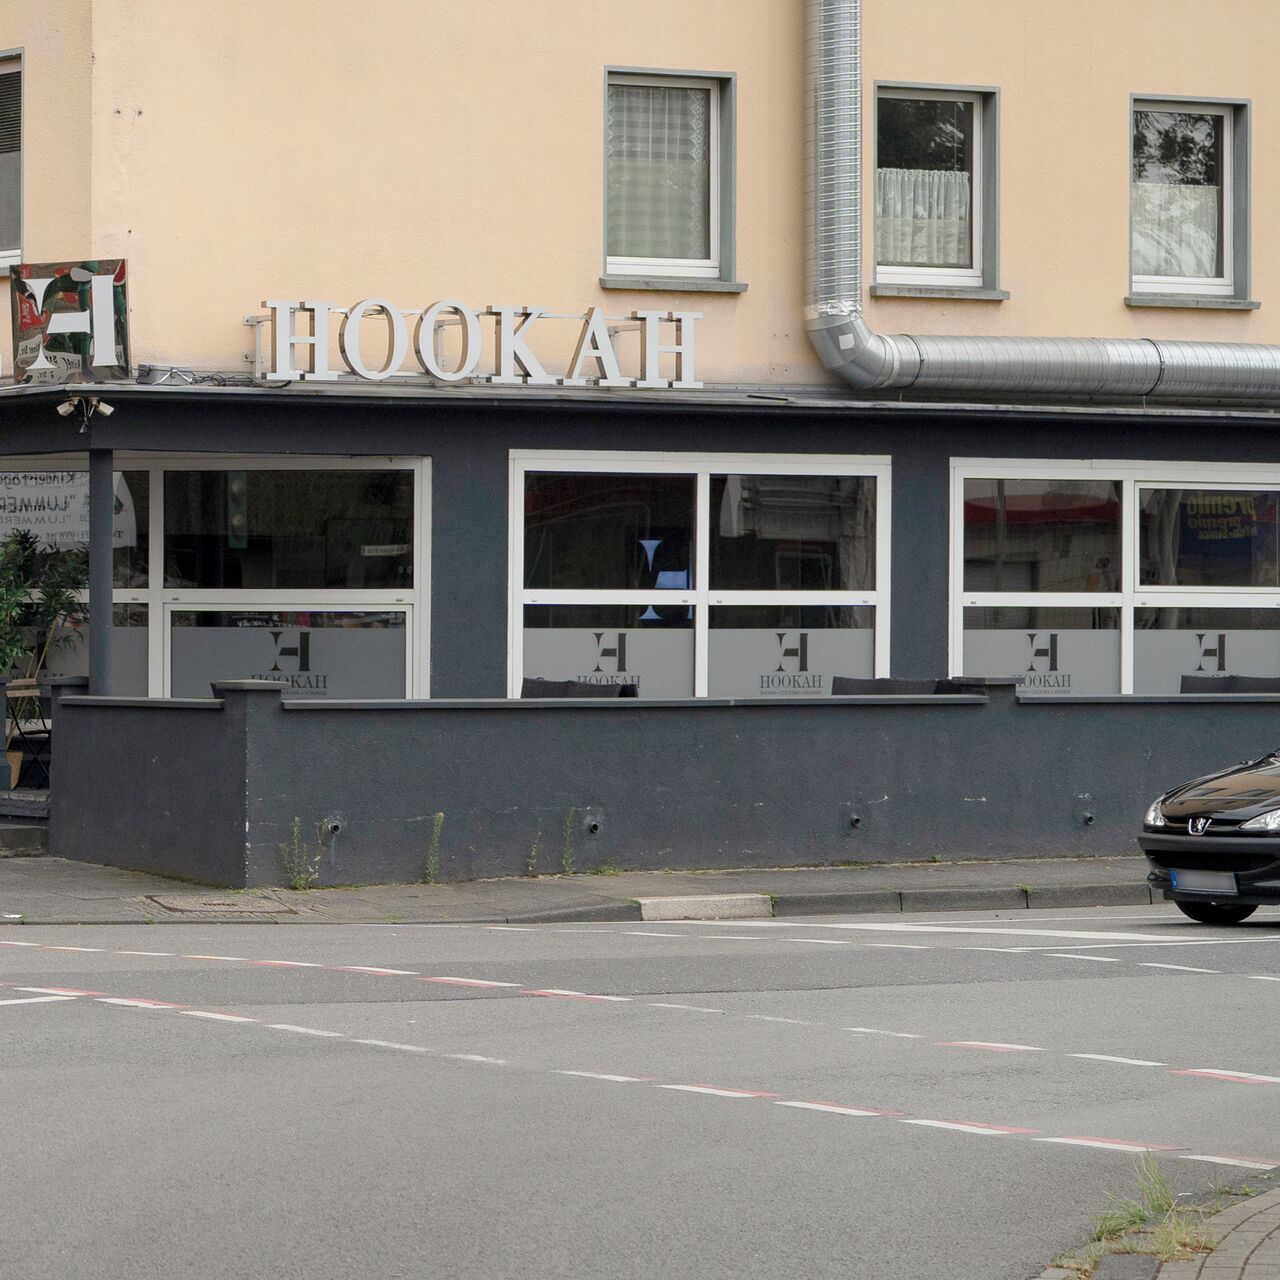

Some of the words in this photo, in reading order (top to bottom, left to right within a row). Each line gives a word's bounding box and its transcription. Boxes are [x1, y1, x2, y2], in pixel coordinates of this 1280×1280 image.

[262, 298, 704, 389] HOOKAH
[759, 674, 823, 689] HOOKAH
[1013, 674, 1072, 688] OOKAH
